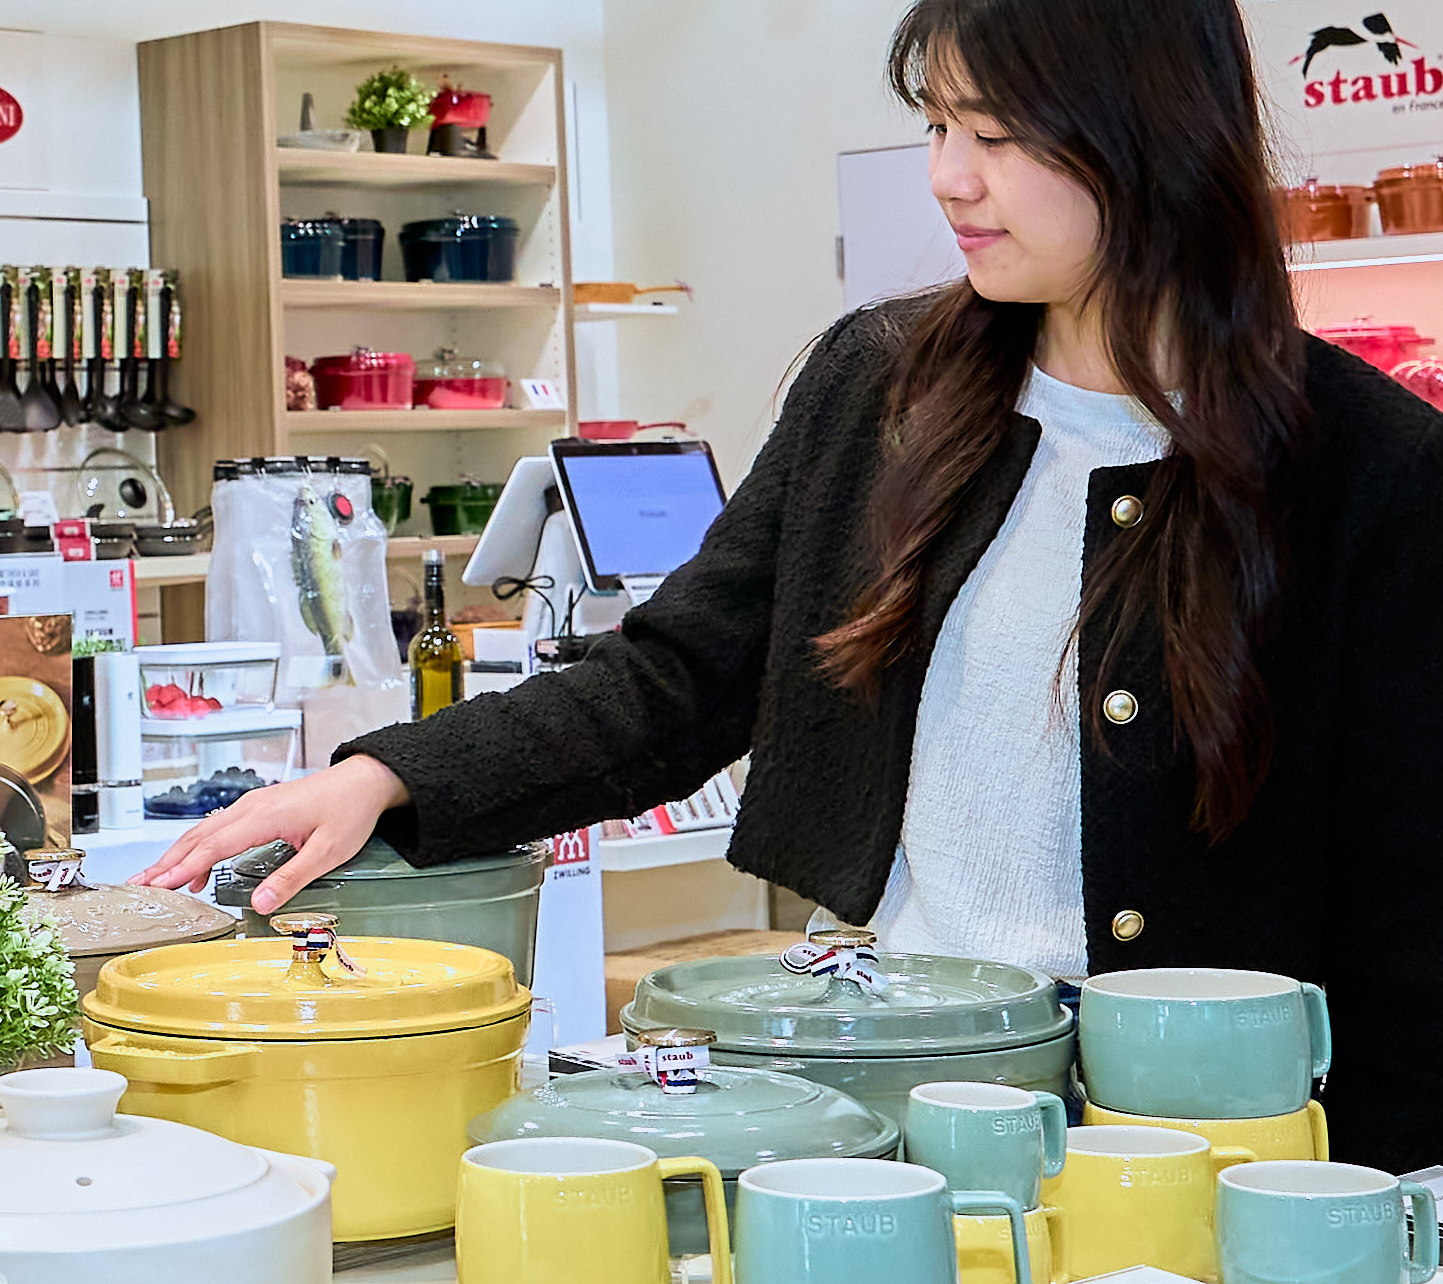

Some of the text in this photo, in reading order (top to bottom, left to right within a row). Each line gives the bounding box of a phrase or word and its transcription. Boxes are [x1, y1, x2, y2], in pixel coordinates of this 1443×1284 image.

[1304, 56, 1443, 108] staub
[554, 866, 591, 881] ZWILLING
[807, 1213, 898, 1237] STAUB
[1327, 1202, 1396, 1228] STAUB
